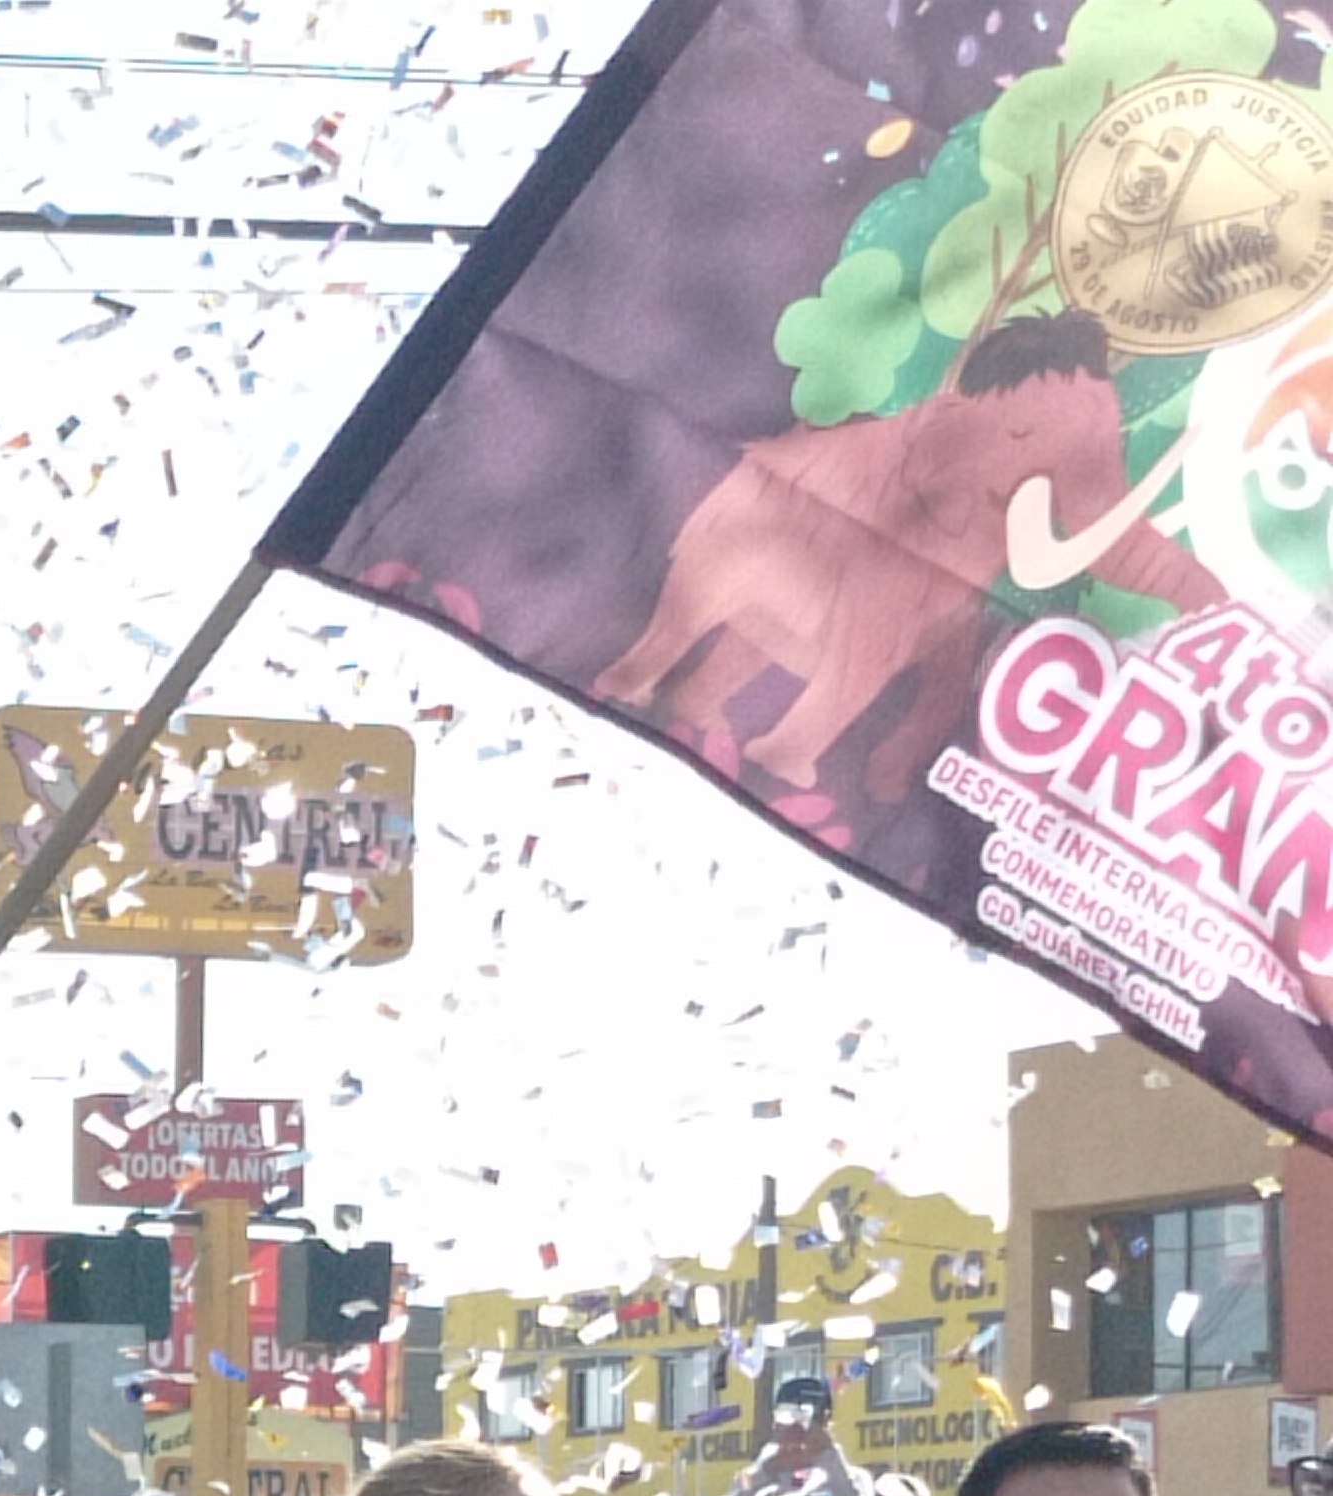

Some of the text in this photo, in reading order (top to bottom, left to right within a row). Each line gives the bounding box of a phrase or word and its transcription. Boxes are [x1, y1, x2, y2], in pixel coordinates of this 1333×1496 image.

[1099, 88, 1208, 149] EQUIDAD
[1230, 94, 1330, 173] JUSTICIA
[1083, 272, 1108, 305] DE
[1104, 298, 1200, 335] AGOSTO
[1166, 616, 1331, 760] 4to
[934, 756, 1057, 843] DESFILE
[987, 840, 1216, 992] CONMEMORATIVO
[1128, 982, 1198, 1041] CHIH.
[120, 1152, 185, 1180] TODO
